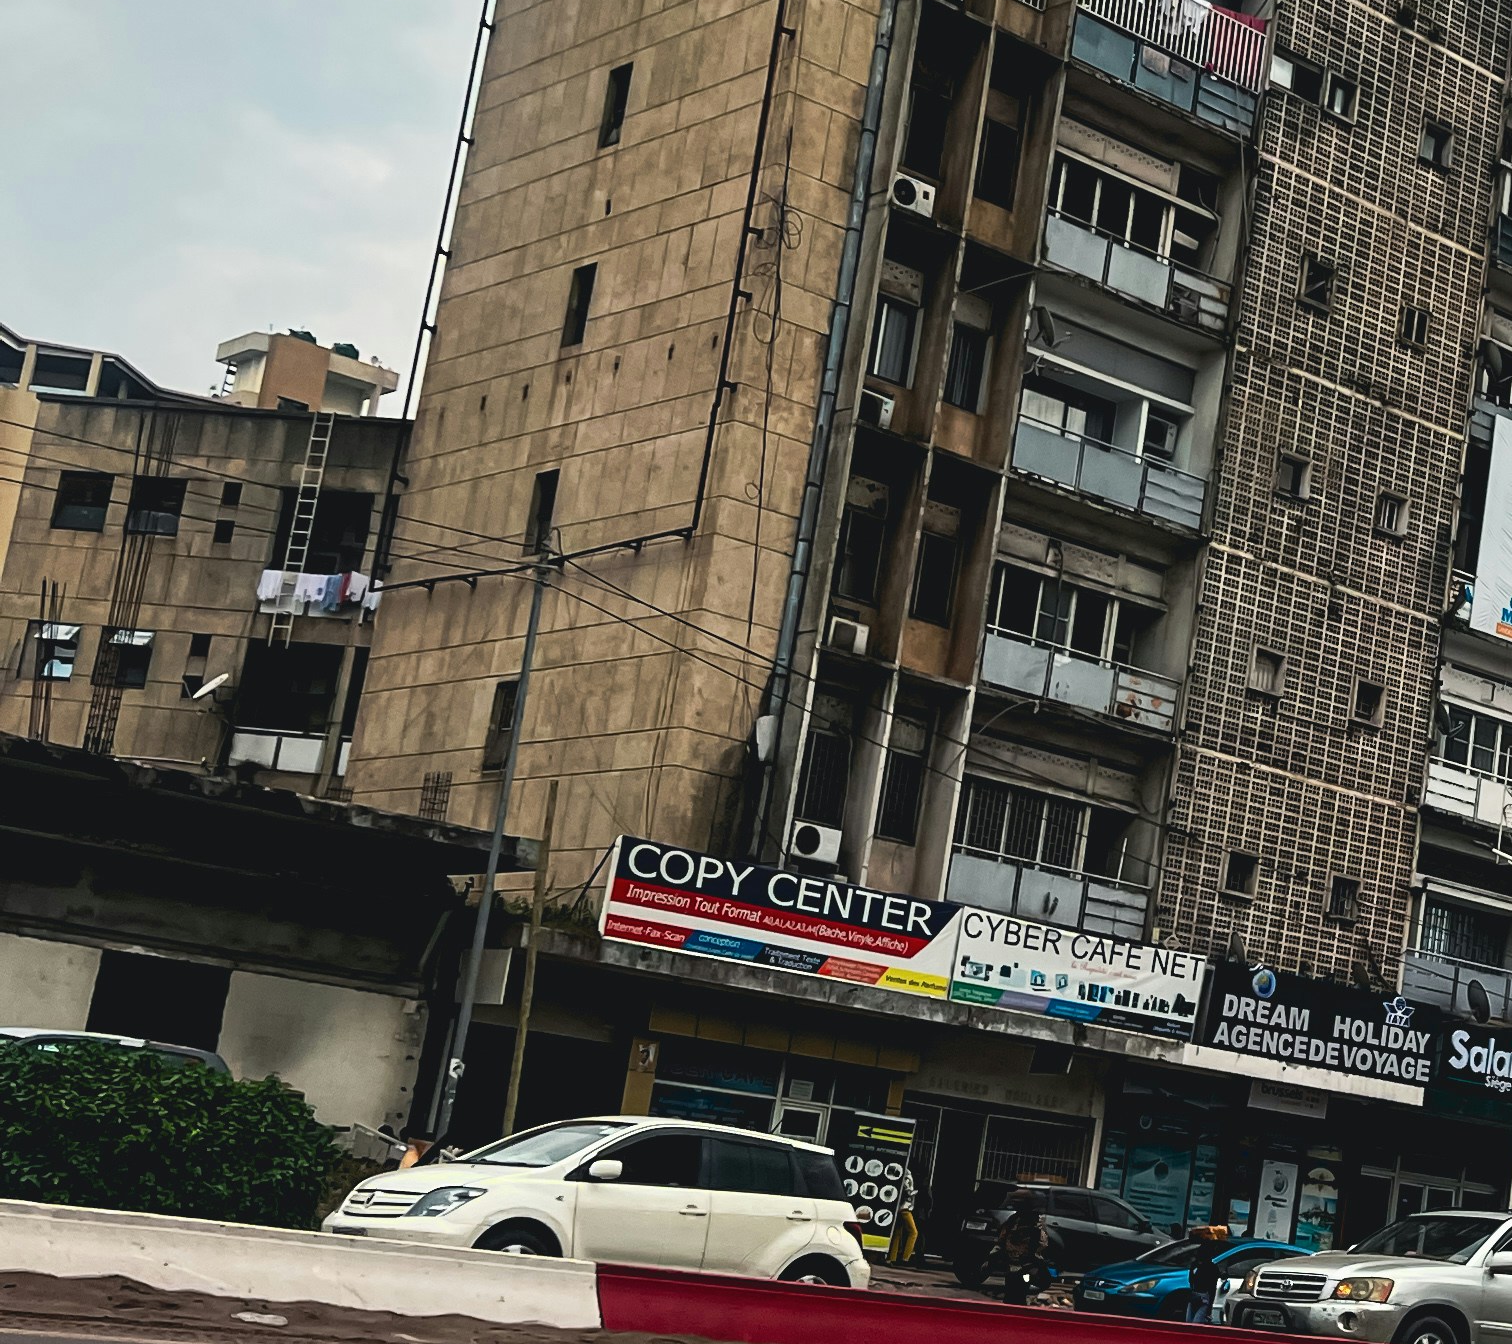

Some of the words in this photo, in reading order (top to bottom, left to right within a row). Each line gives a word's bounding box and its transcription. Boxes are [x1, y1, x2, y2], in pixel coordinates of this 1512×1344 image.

[626, 884, 691, 909] Impression
[694, 896, 719, 915] Tout
[721, 903, 761, 923] Format
[628, 844, 755, 896] COPY
[767, 873, 933, 936] CENTER
[964, 912, 1062, 956] CYBER
[1071, 934, 1144, 971] CAFE
[1151, 948, 1206, 982] NET
[1212, 1021, 1309, 1059] AGENCE
[1342, 1043, 1431, 1082] VOYAGE
[1222, 993, 1310, 1032] DREAM
[1332, 1015, 1431, 1054] HOLIDAY
[1261, 1082, 1303, 1101] brussels
